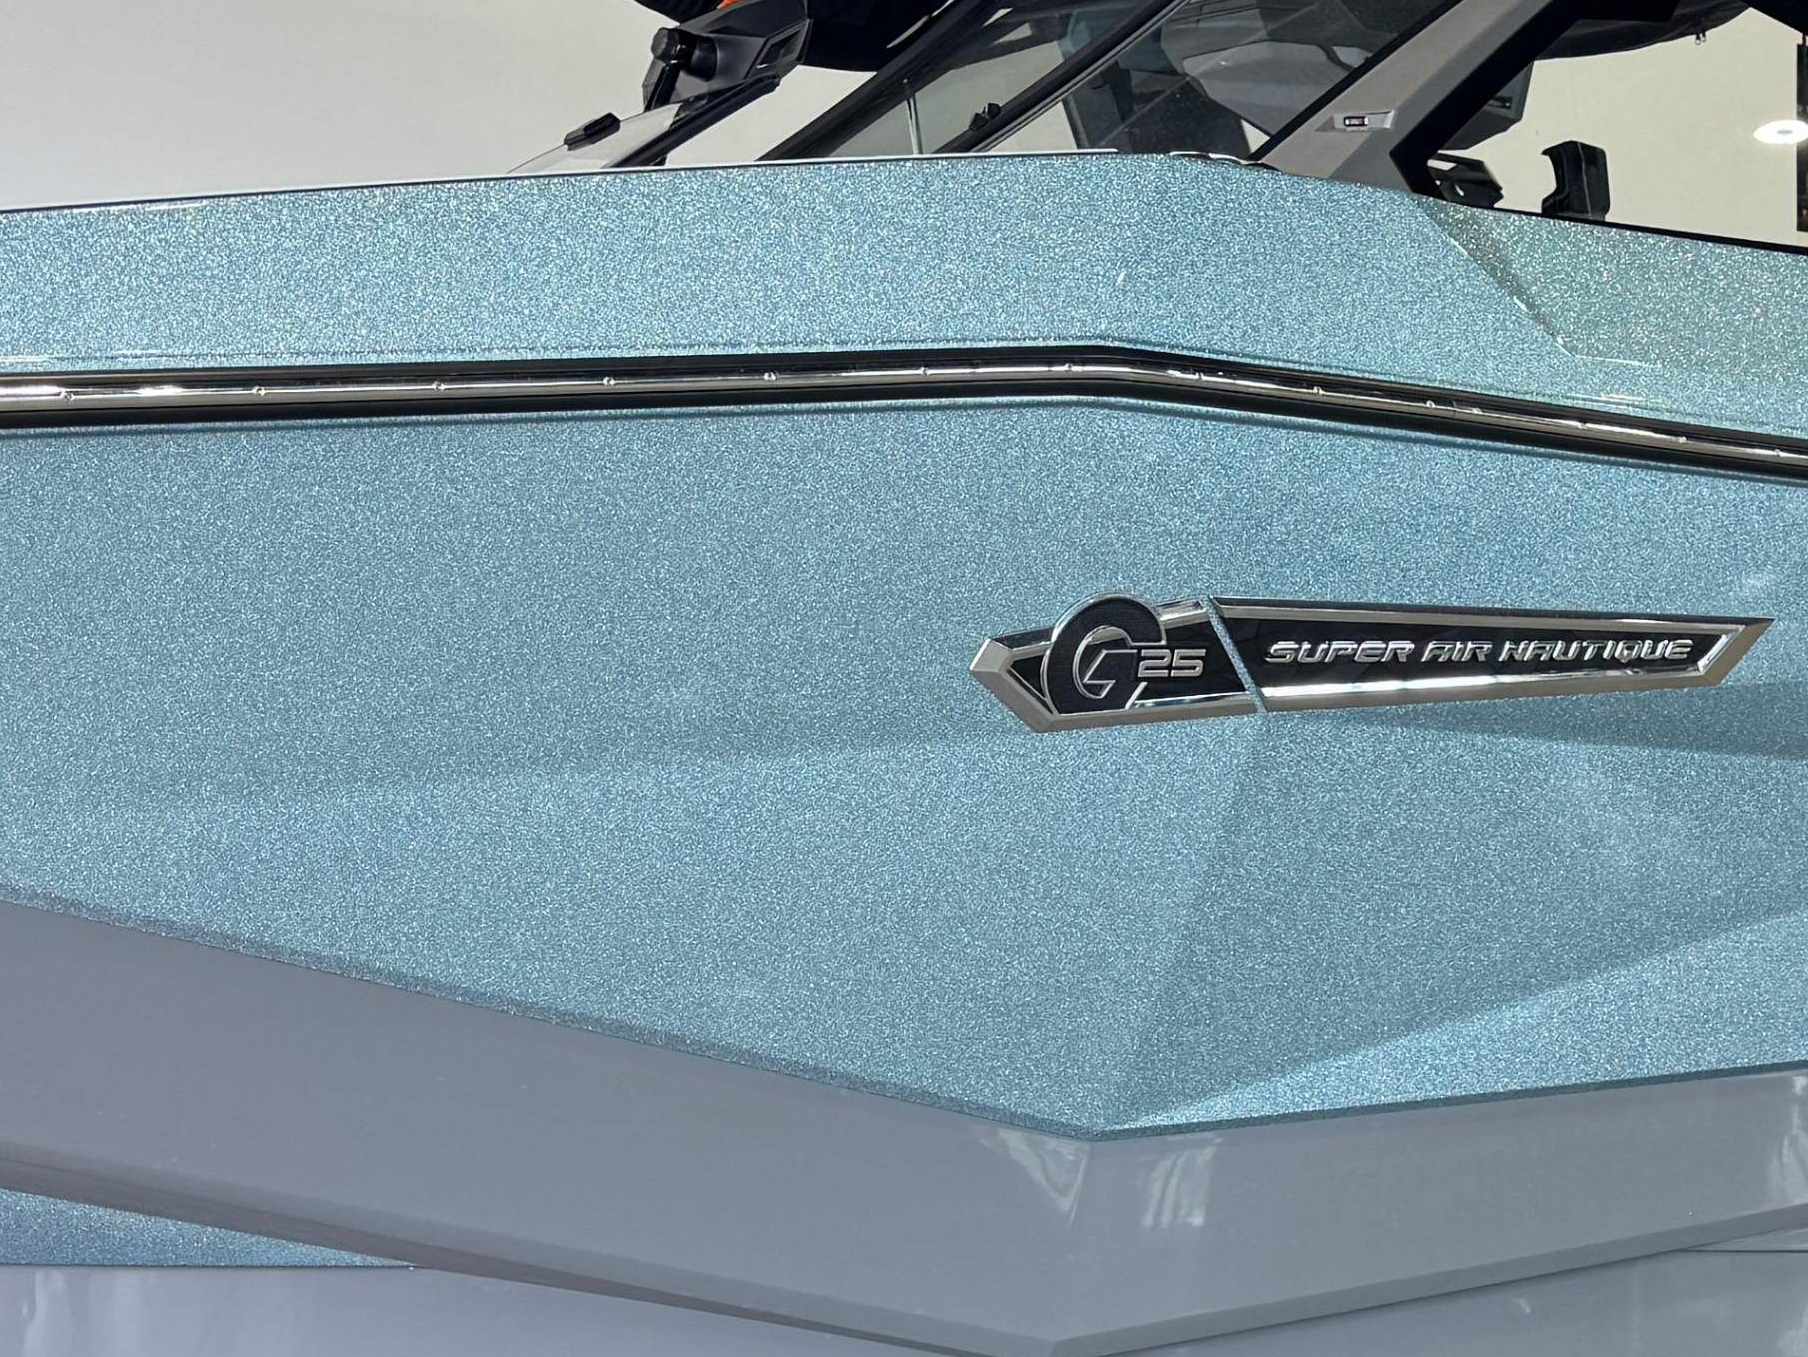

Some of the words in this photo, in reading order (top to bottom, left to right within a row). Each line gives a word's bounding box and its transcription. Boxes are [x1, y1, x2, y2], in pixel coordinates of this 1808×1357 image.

[1265, 640, 1416, 663] SUPER
[1420, 640, 1493, 662] AIR
[1498, 639, 1694, 663] NAUTIQUE
